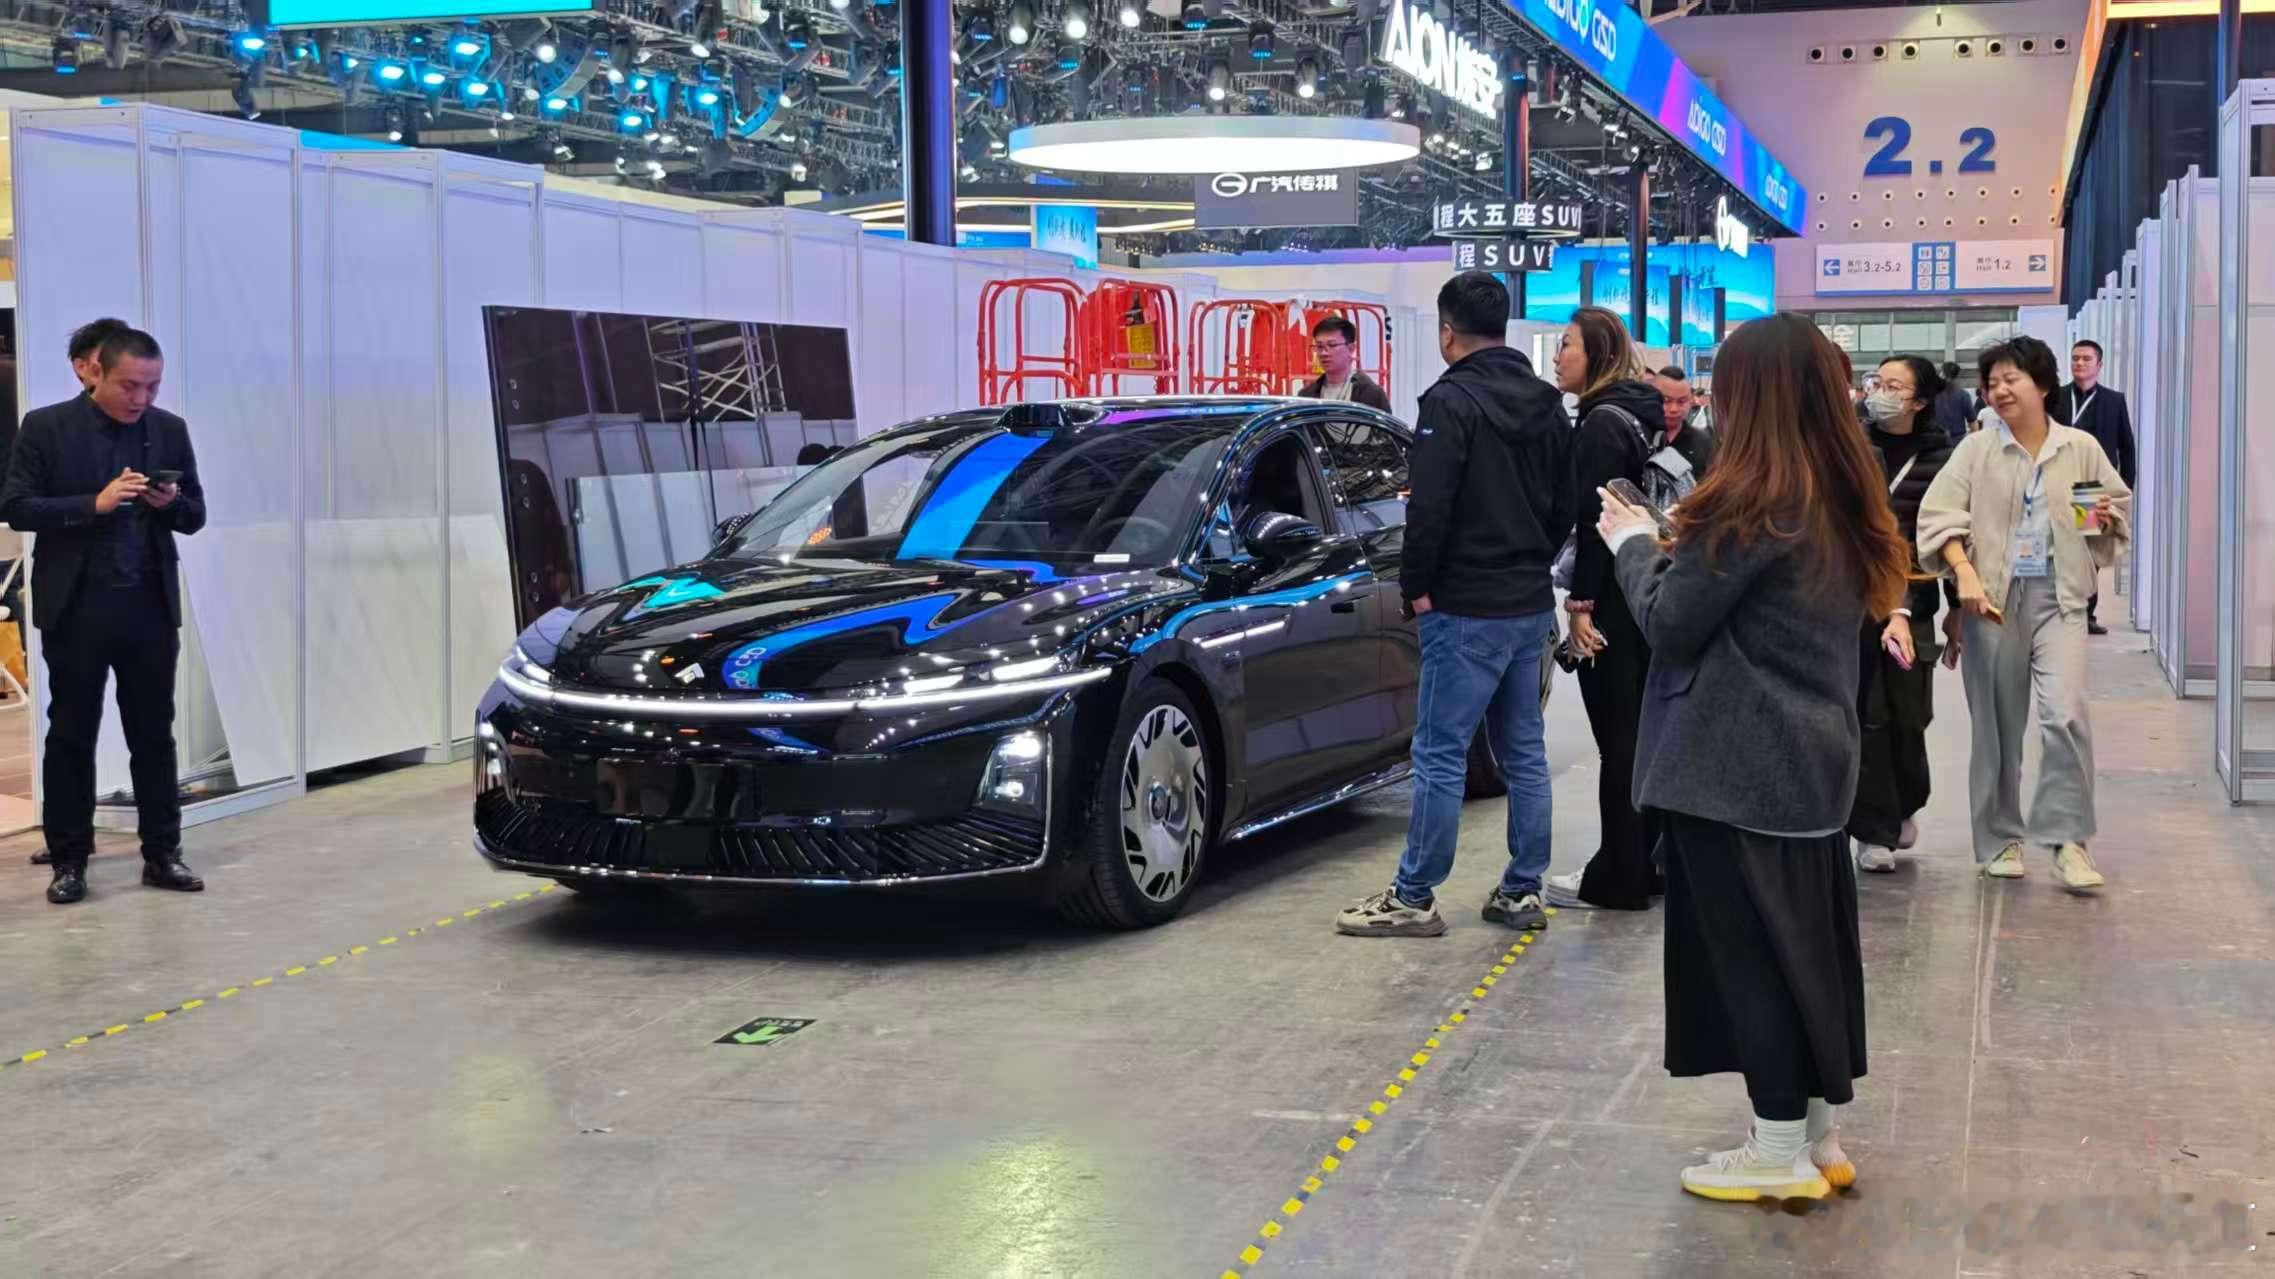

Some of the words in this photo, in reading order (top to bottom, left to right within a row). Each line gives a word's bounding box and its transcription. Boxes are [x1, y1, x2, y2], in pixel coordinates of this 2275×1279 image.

[1384, 0, 1457, 97] AION
[1863, 116, 1996, 176] 2.2
[1458, 242, 1553, 268] 程SUV
[1864, 260, 1903, 273] 3.2-5.2
[1994, 257, 2012, 271] 1.2
